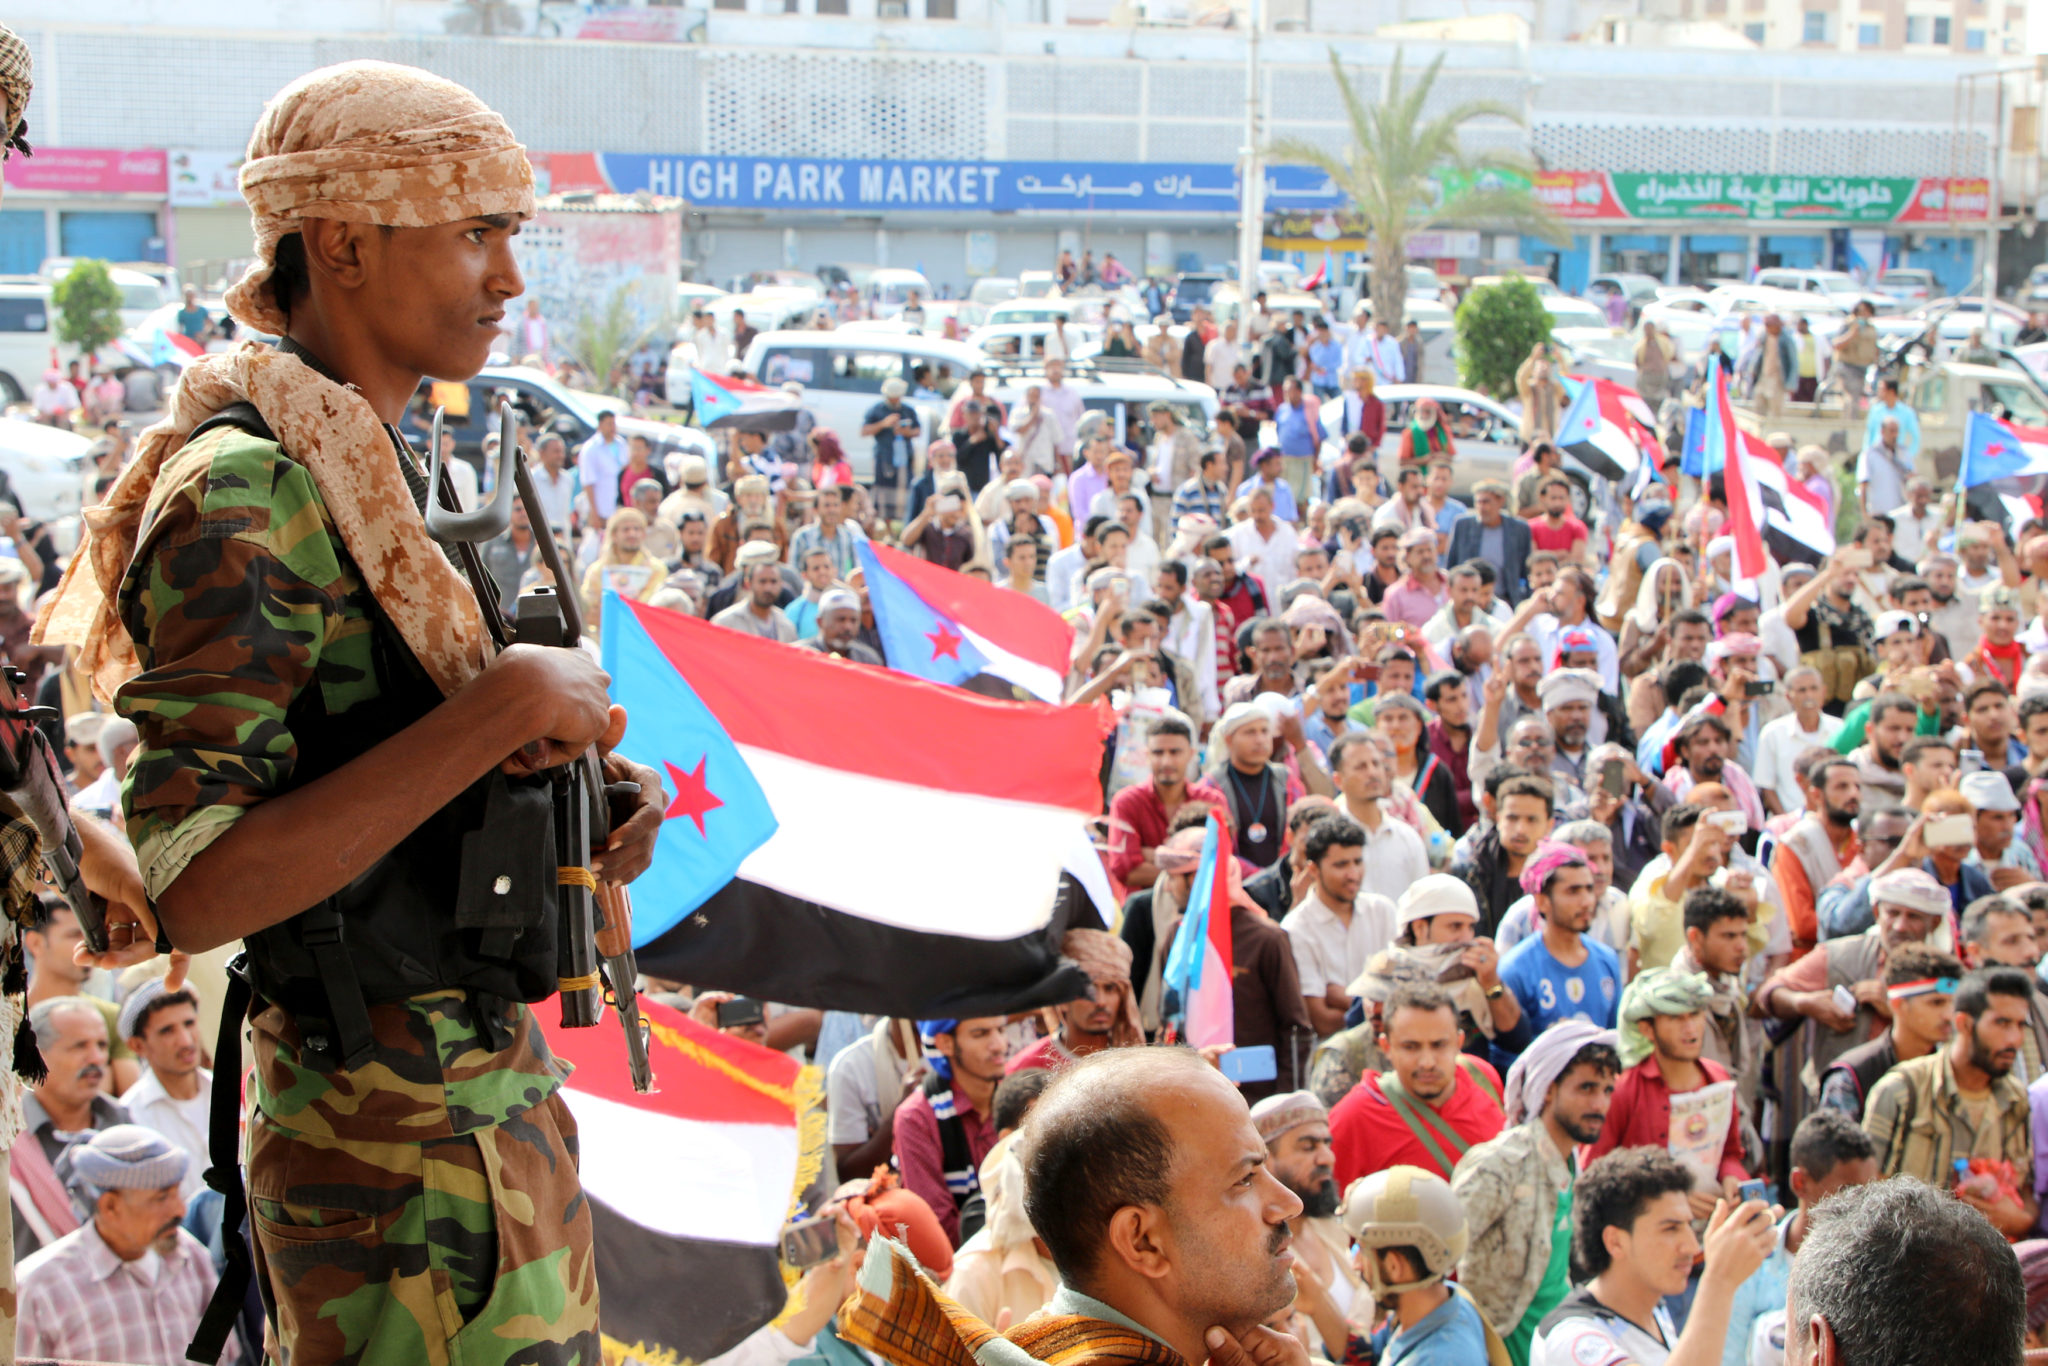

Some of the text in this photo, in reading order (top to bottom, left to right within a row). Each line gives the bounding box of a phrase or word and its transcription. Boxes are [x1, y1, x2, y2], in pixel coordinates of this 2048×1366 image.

[648, 159, 1001, 203] HIGH PARK MARKET
[1016, 173, 1144, 199] ماركت
[1636, 175, 1723, 205] الخضراء
[1812, 178, 1893, 209] حلويات
[1539, 978, 1557, 1010] 3
